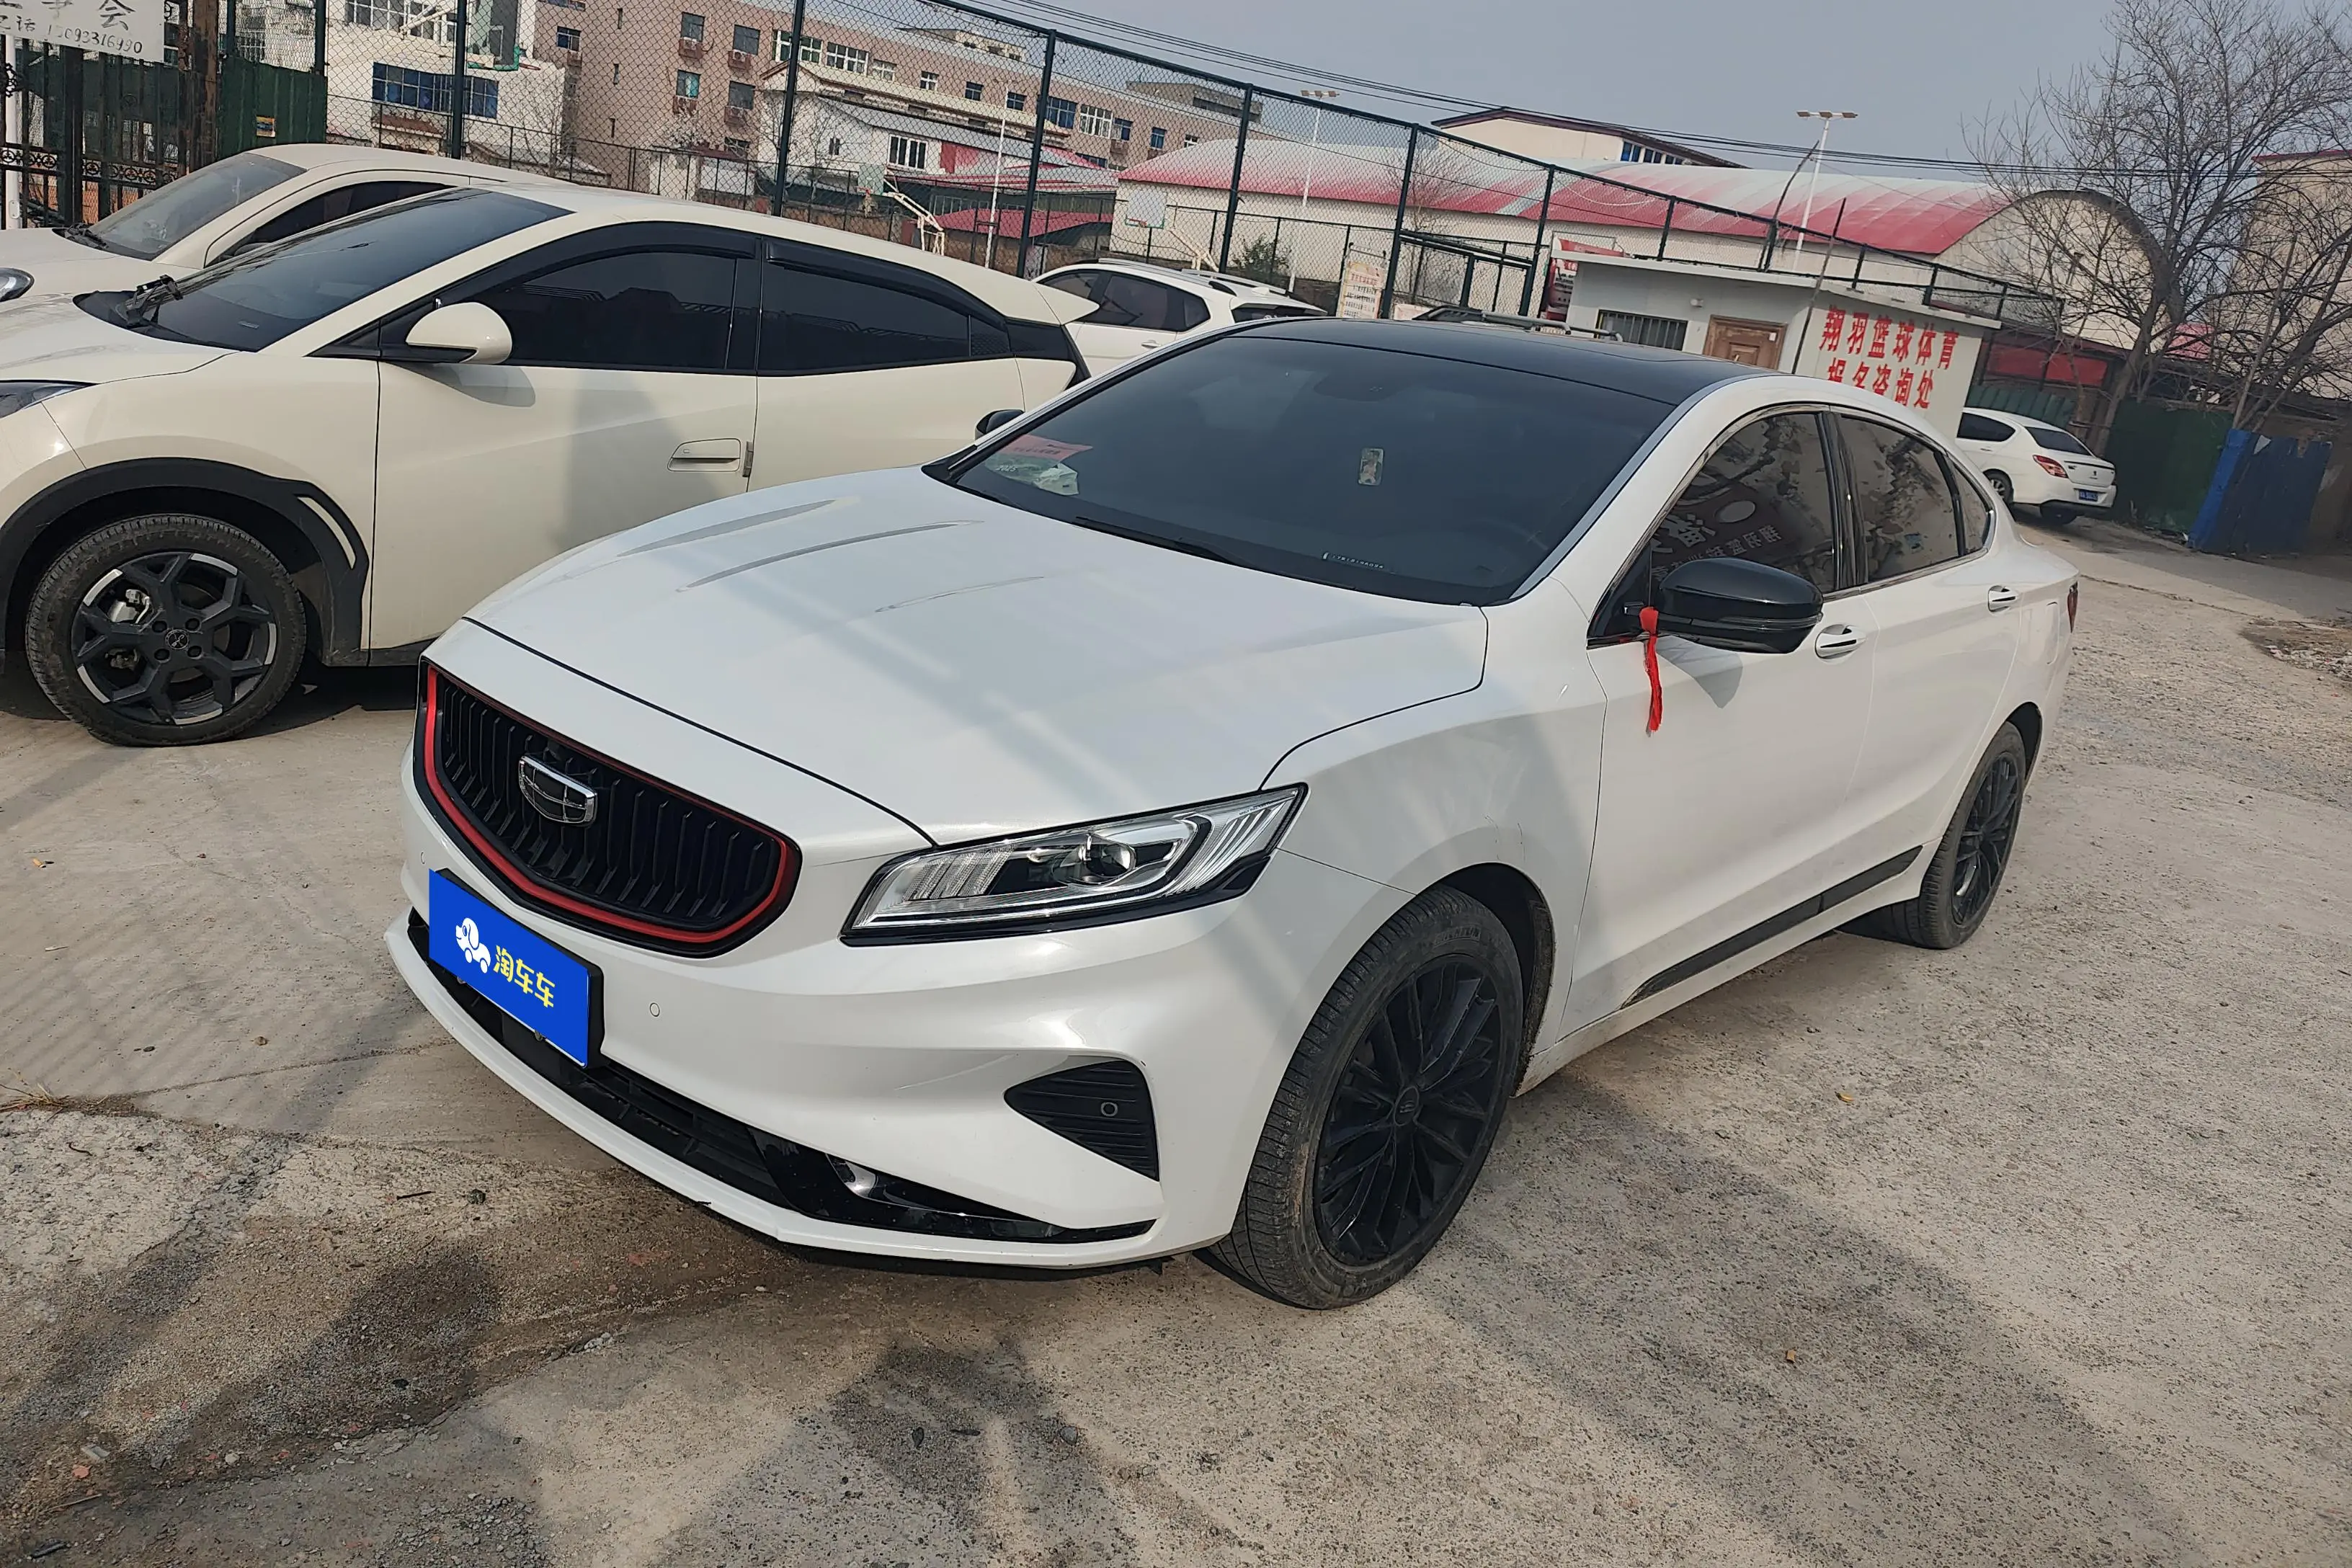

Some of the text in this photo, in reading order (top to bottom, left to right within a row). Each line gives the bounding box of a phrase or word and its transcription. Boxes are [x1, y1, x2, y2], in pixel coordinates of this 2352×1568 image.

[1818, 305, 1960, 370] 翔羽篮球体育
[1827, 357, 1934, 409] 报名咨询处
